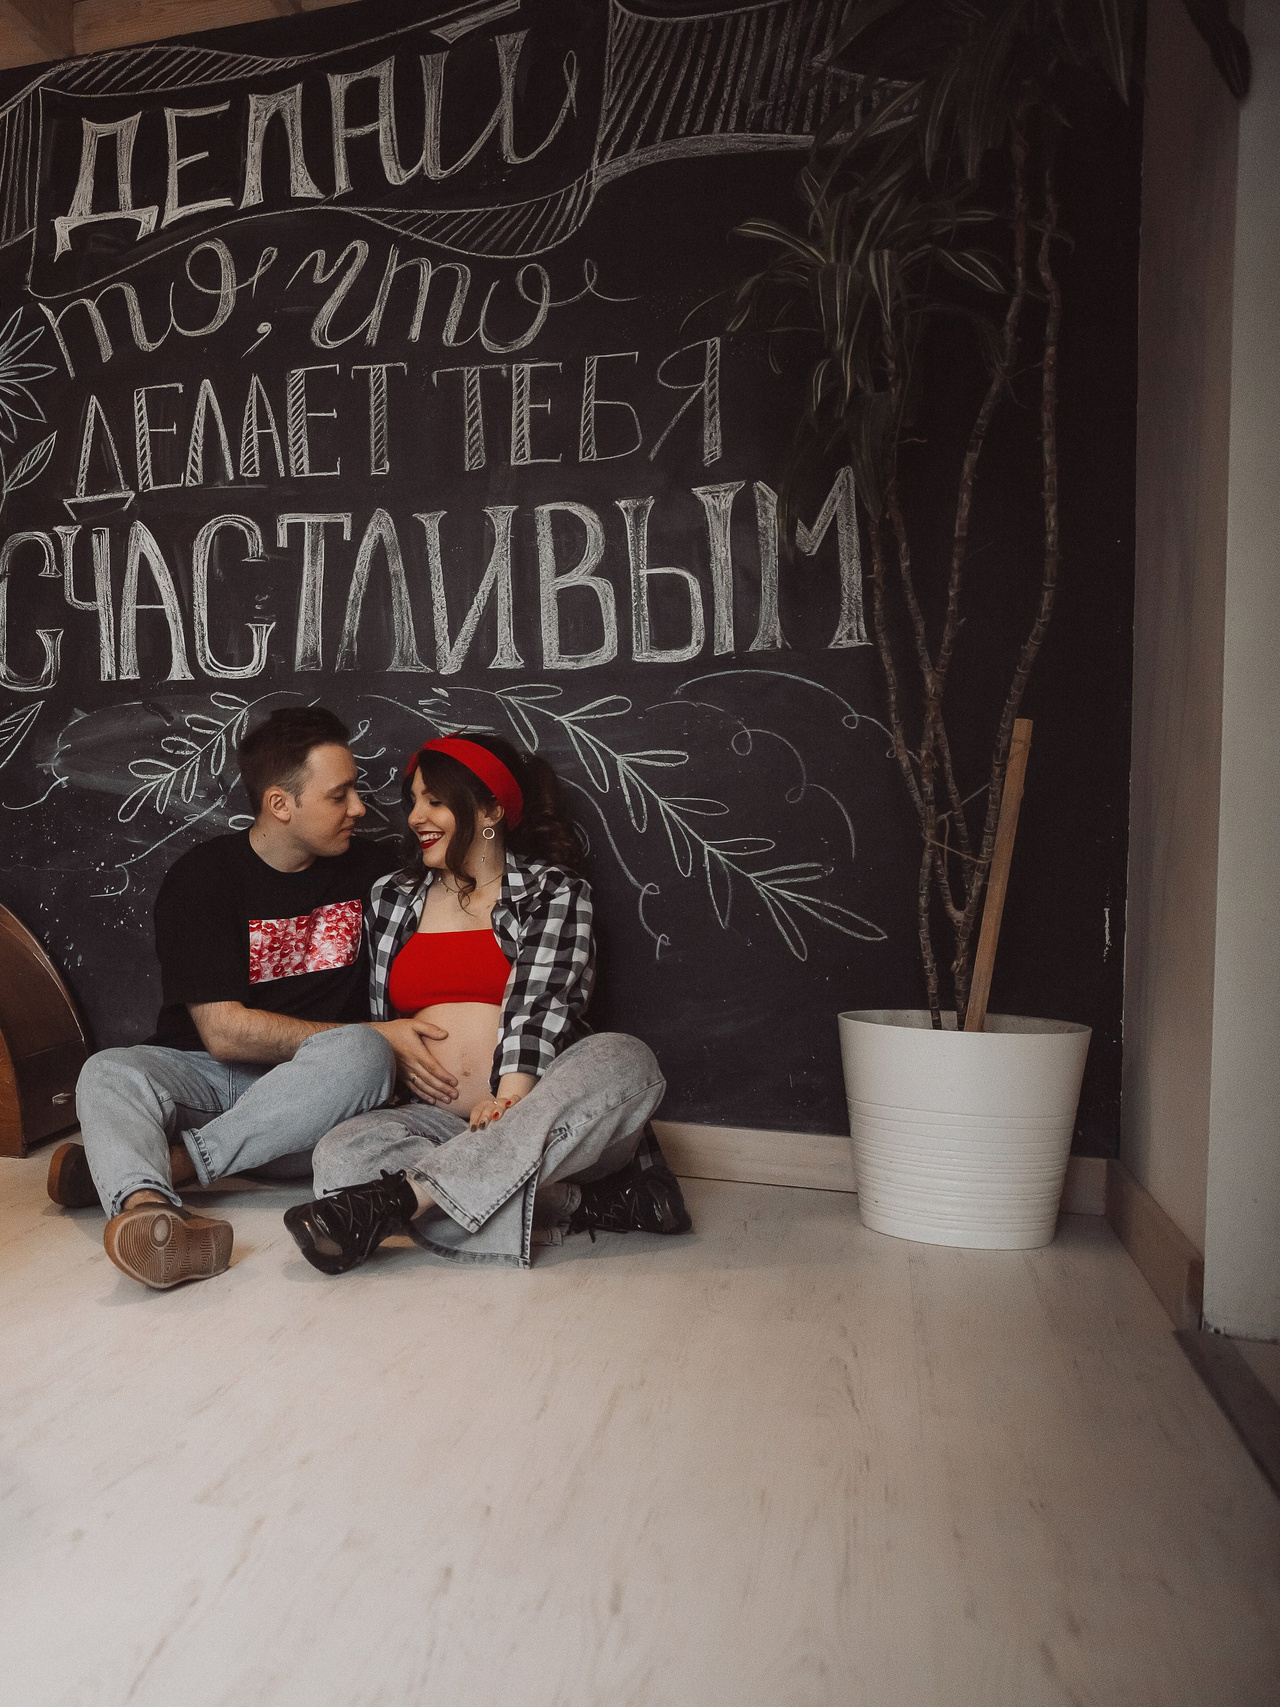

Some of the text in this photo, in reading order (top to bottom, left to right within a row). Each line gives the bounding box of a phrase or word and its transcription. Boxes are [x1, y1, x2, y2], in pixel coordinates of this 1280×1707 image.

[53, 0, 579, 262] ДЕЛАЙ
[287, 239, 640, 353] что
[63, 337, 721, 520] ДЕЛАЕТ ТЕБЯ
